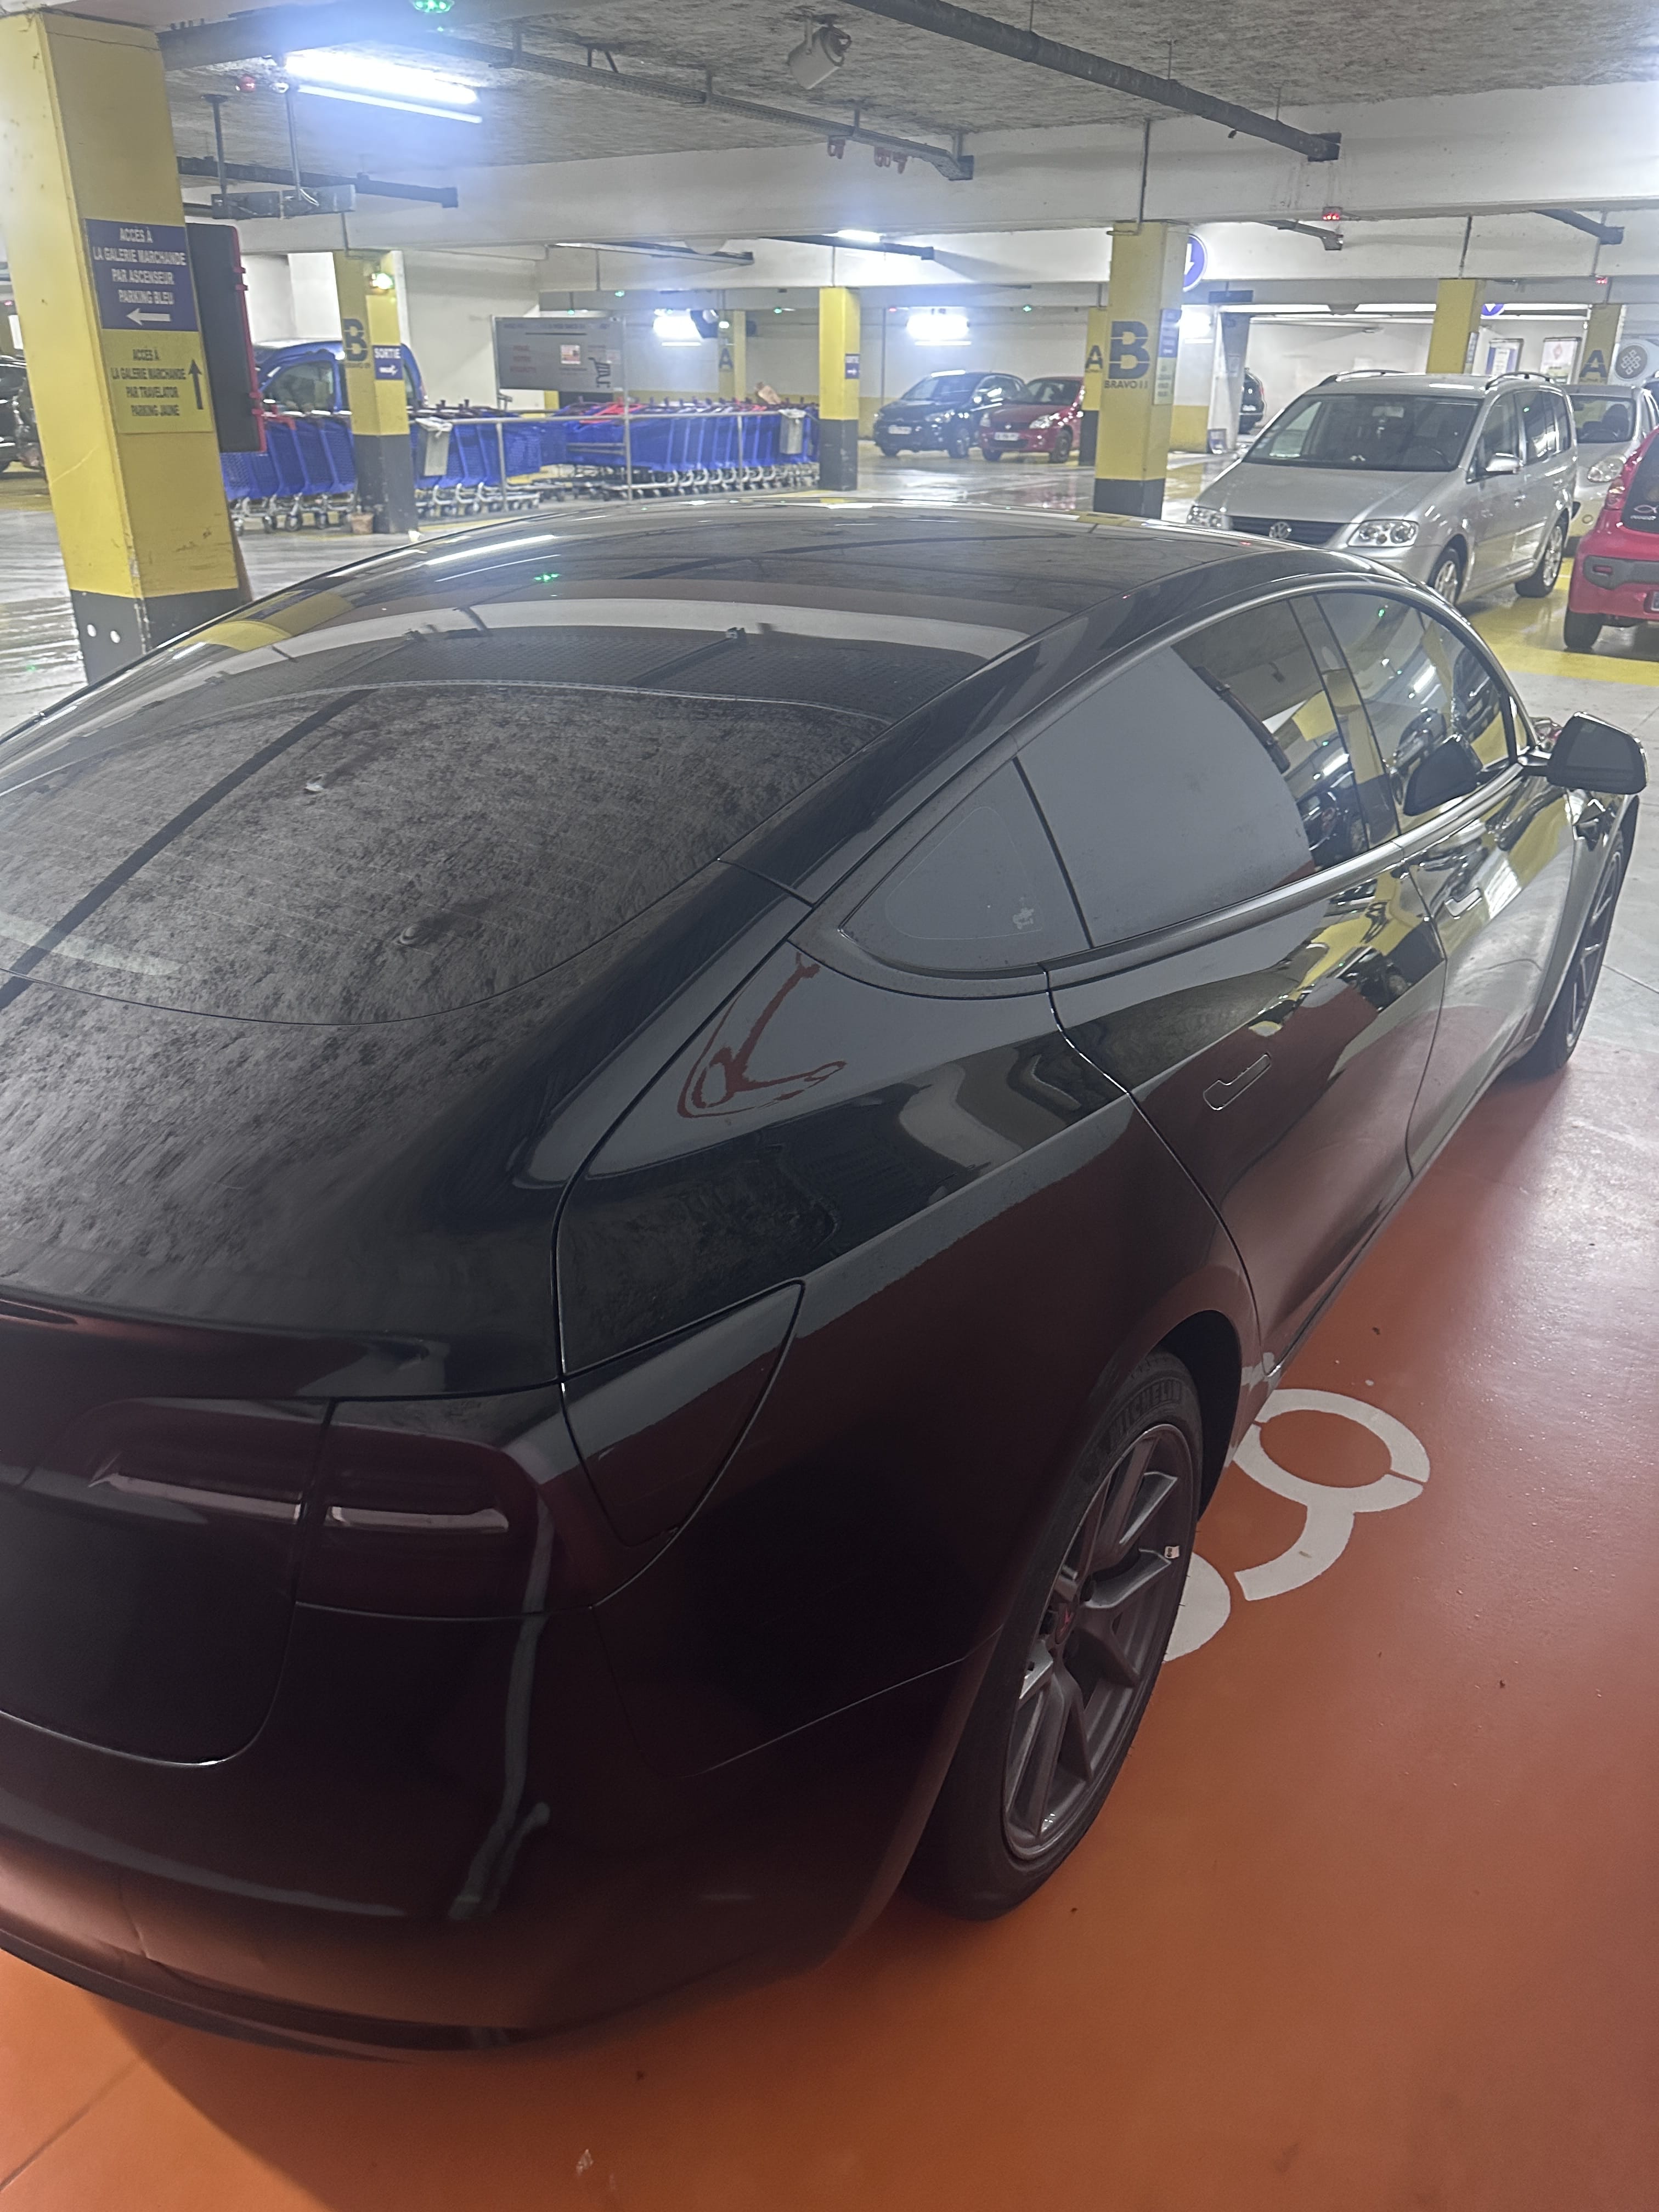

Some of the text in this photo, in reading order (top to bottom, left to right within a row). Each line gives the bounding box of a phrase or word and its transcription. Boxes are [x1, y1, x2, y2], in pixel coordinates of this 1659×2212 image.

[93, 246, 187, 266] LA GALERIE MARCHANDE
[111, 268, 175, 285] PAR ASCENSEUR
[119, 289, 175, 305] PARKING BLEU
[343, 318, 368, 361] B
[374, 347, 401, 359] SORTIE
[718, 347, 733, 369] A
[1086, 345, 1103, 369] A
[1109, 321, 1150, 379] B
[1579, 349, 1607, 377] A
[111, 367, 187, 380] LA GALERIE MARCHANDE
[126, 386, 180, 398] PAR TRAVELATOR
[1104, 380, 1137, 389] BRAVO
[131, 404, 180, 416] PARKING JAUNE
